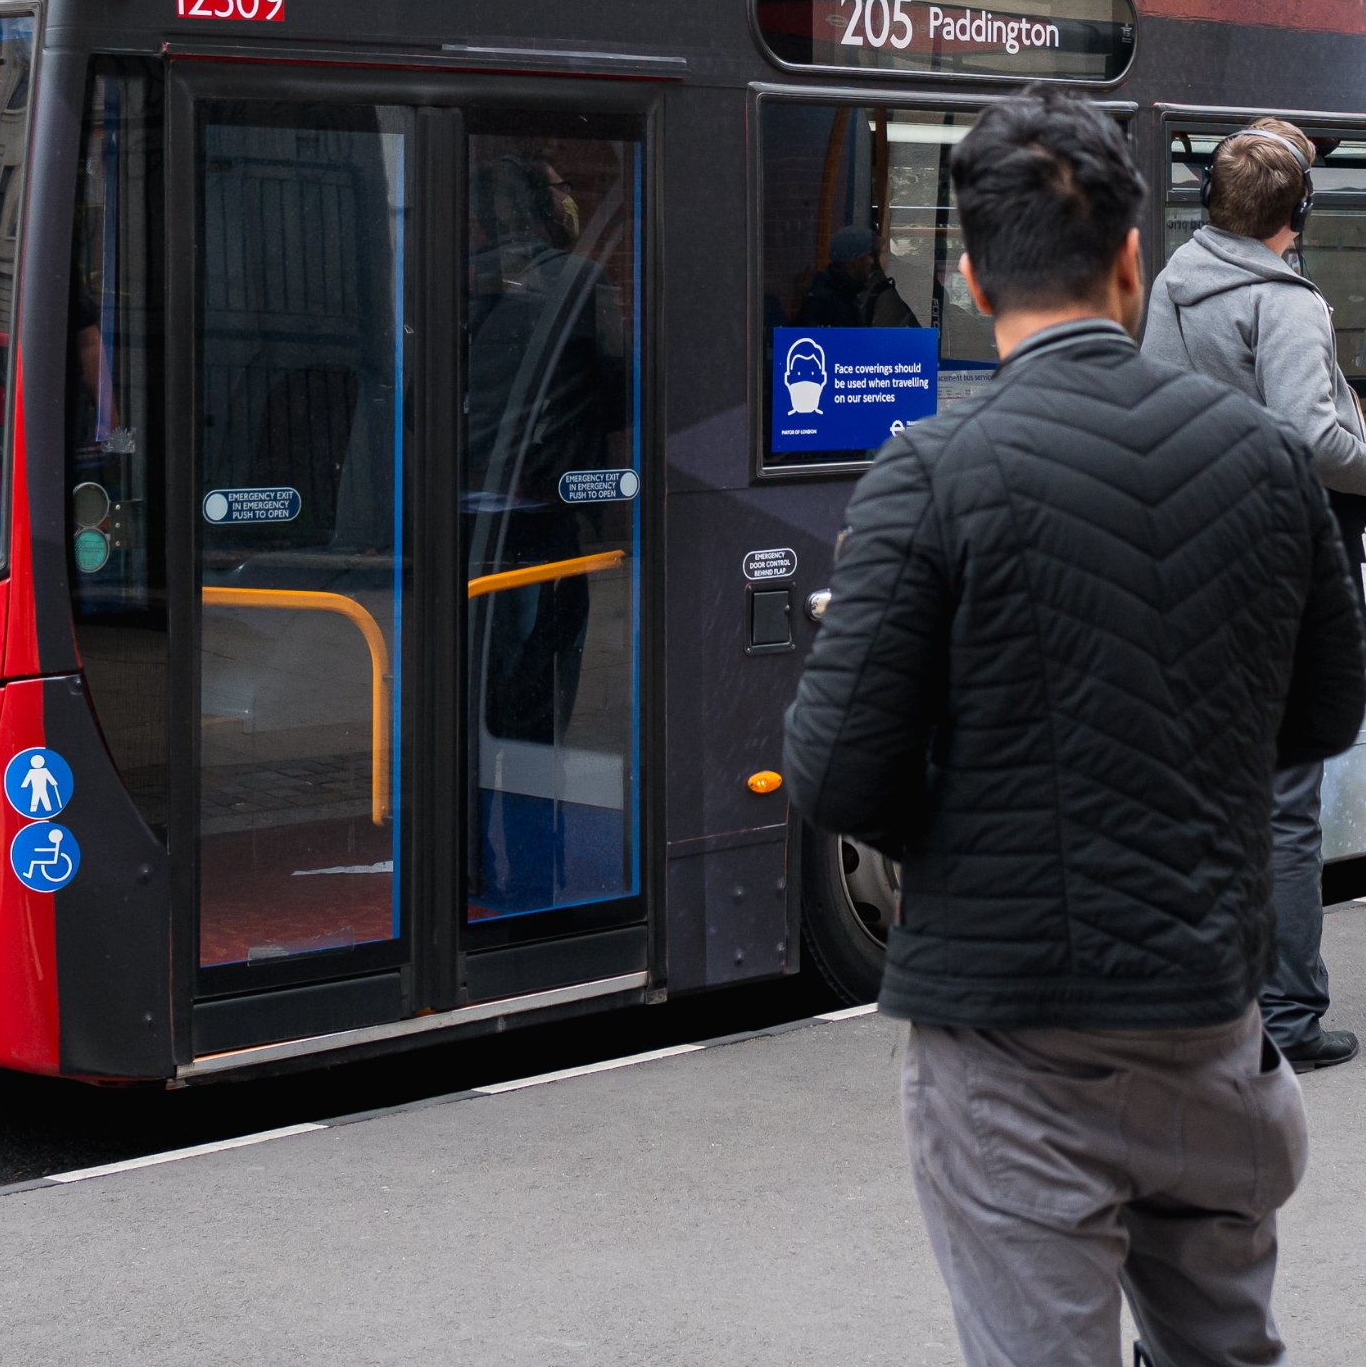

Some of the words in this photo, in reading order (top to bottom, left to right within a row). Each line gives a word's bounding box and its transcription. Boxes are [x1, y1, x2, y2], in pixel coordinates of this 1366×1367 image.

[929, 6, 1060, 55] Paddington
[835, 363, 853, 374] Face
[855, 363, 893, 376] coverings
[894, 362, 921, 373] should
[938, 374, 962, 382] acement
[964, 373, 974, 381] bus
[835, 378, 845, 389] be
[847, 378, 866, 389] used
[868, 377, 891, 389] when
[892, 377, 929, 390] travelling
[834, 395, 846, 404] on
[847, 395, 861, 404] our
[863, 393, 896, 403] services
[565, 474, 604, 483] EMERGENCY
[606, 473, 620, 481] EXIT
[569, 483, 577, 491] IN
[578, 482, 616, 491] EMERGENCY
[228, 492, 275, 502] EMERGENCY
[277, 491, 294, 500] EXIT
[569, 492, 586, 500] PUSH
[588, 491, 597, 499] TO
[598, 490, 616, 498] OPEN
[232, 502, 241, 510] IN
[243, 500, 290, 510] EMERGENCY
[232, 511, 253, 520] PUSH
[255, 511, 266, 519] TO
[267, 509, 289, 518] OPEN
[754, 552, 785, 561] EMERGENCY
[750, 562, 765, 570] DOOR
[766, 559, 791, 568] CONTROL
[754, 569, 773, 577] BEHIND
